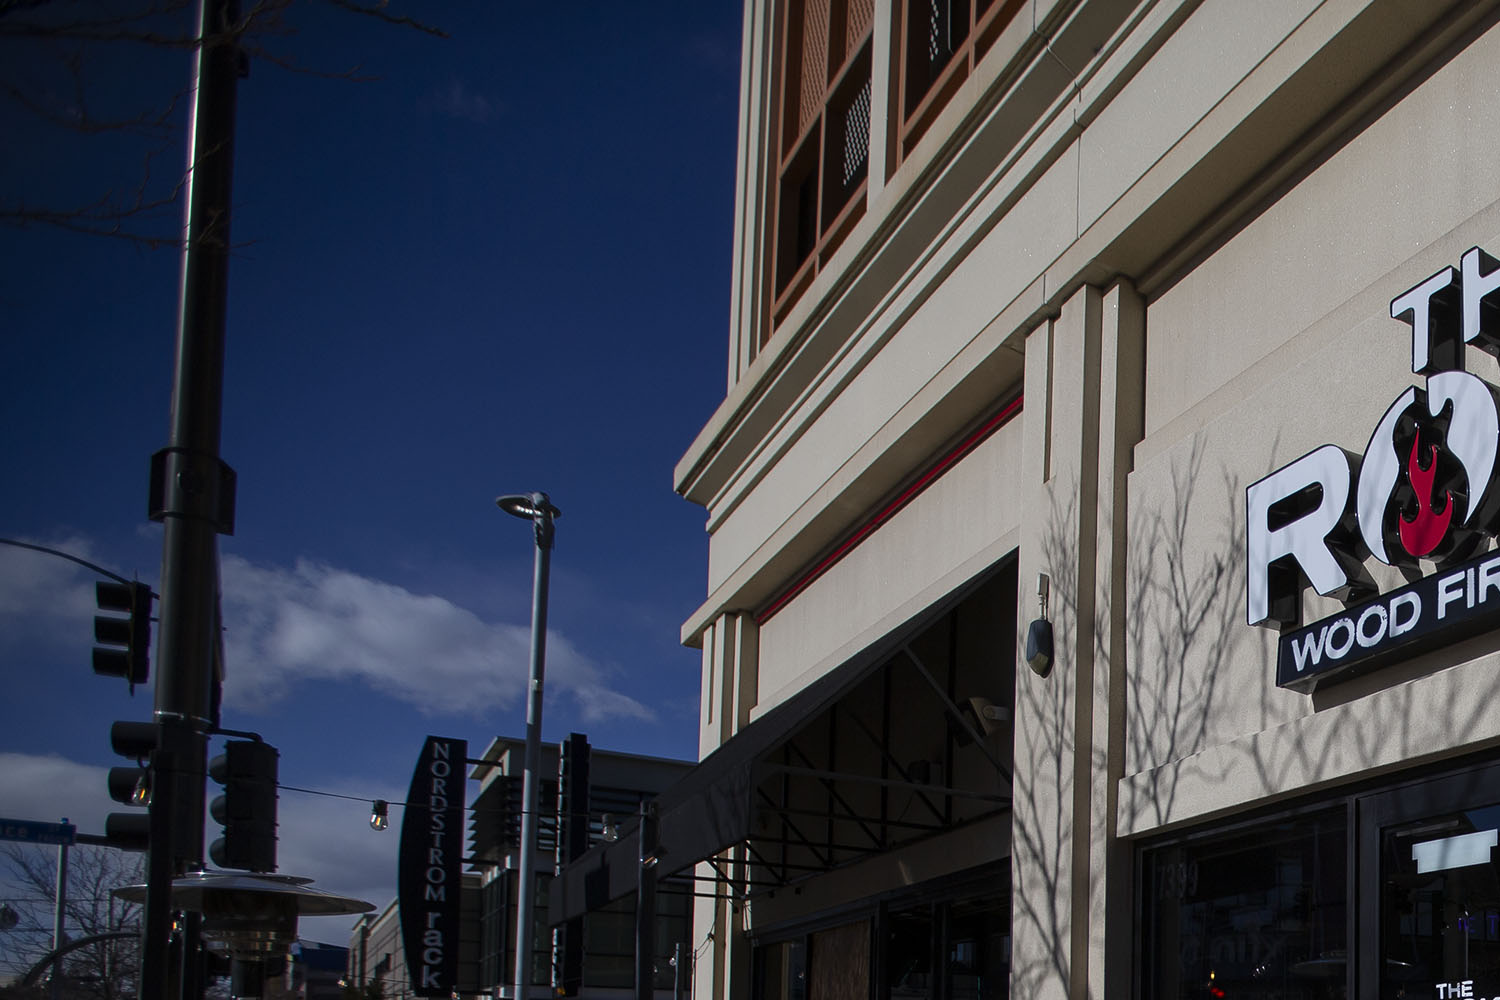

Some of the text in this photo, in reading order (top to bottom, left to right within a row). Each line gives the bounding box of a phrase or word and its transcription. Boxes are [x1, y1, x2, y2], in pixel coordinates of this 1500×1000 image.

[1292, 598, 1421, 673] WOOD
[425, 741, 451, 902] NORDSTROM
[422, 911, 444, 990] rack
[1436, 980, 1473, 1000] THE
